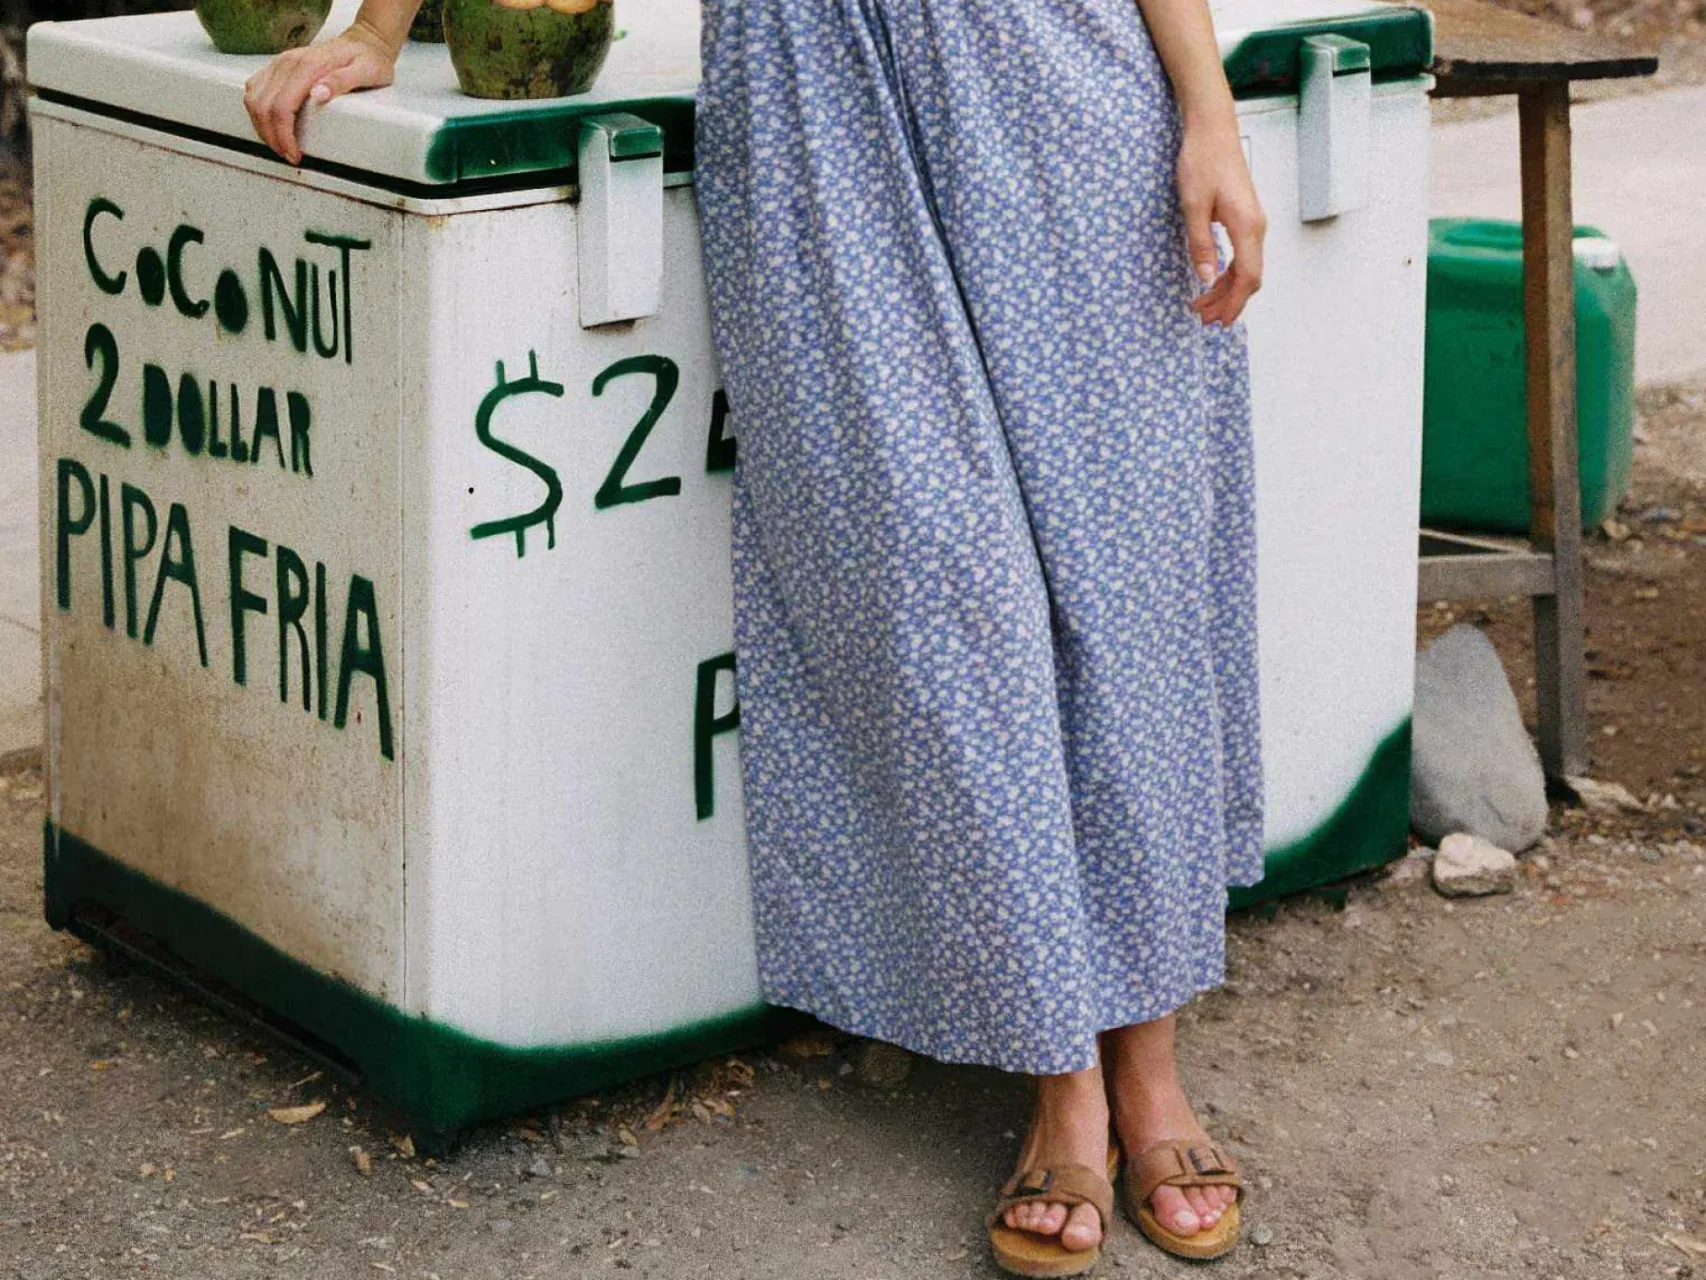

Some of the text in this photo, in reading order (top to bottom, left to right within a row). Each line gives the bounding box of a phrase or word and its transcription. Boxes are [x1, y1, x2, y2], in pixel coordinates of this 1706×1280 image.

[80, 322, 314, 478] 2 DOLLAR
[57, 458, 394, 761] PIPA FRIA
